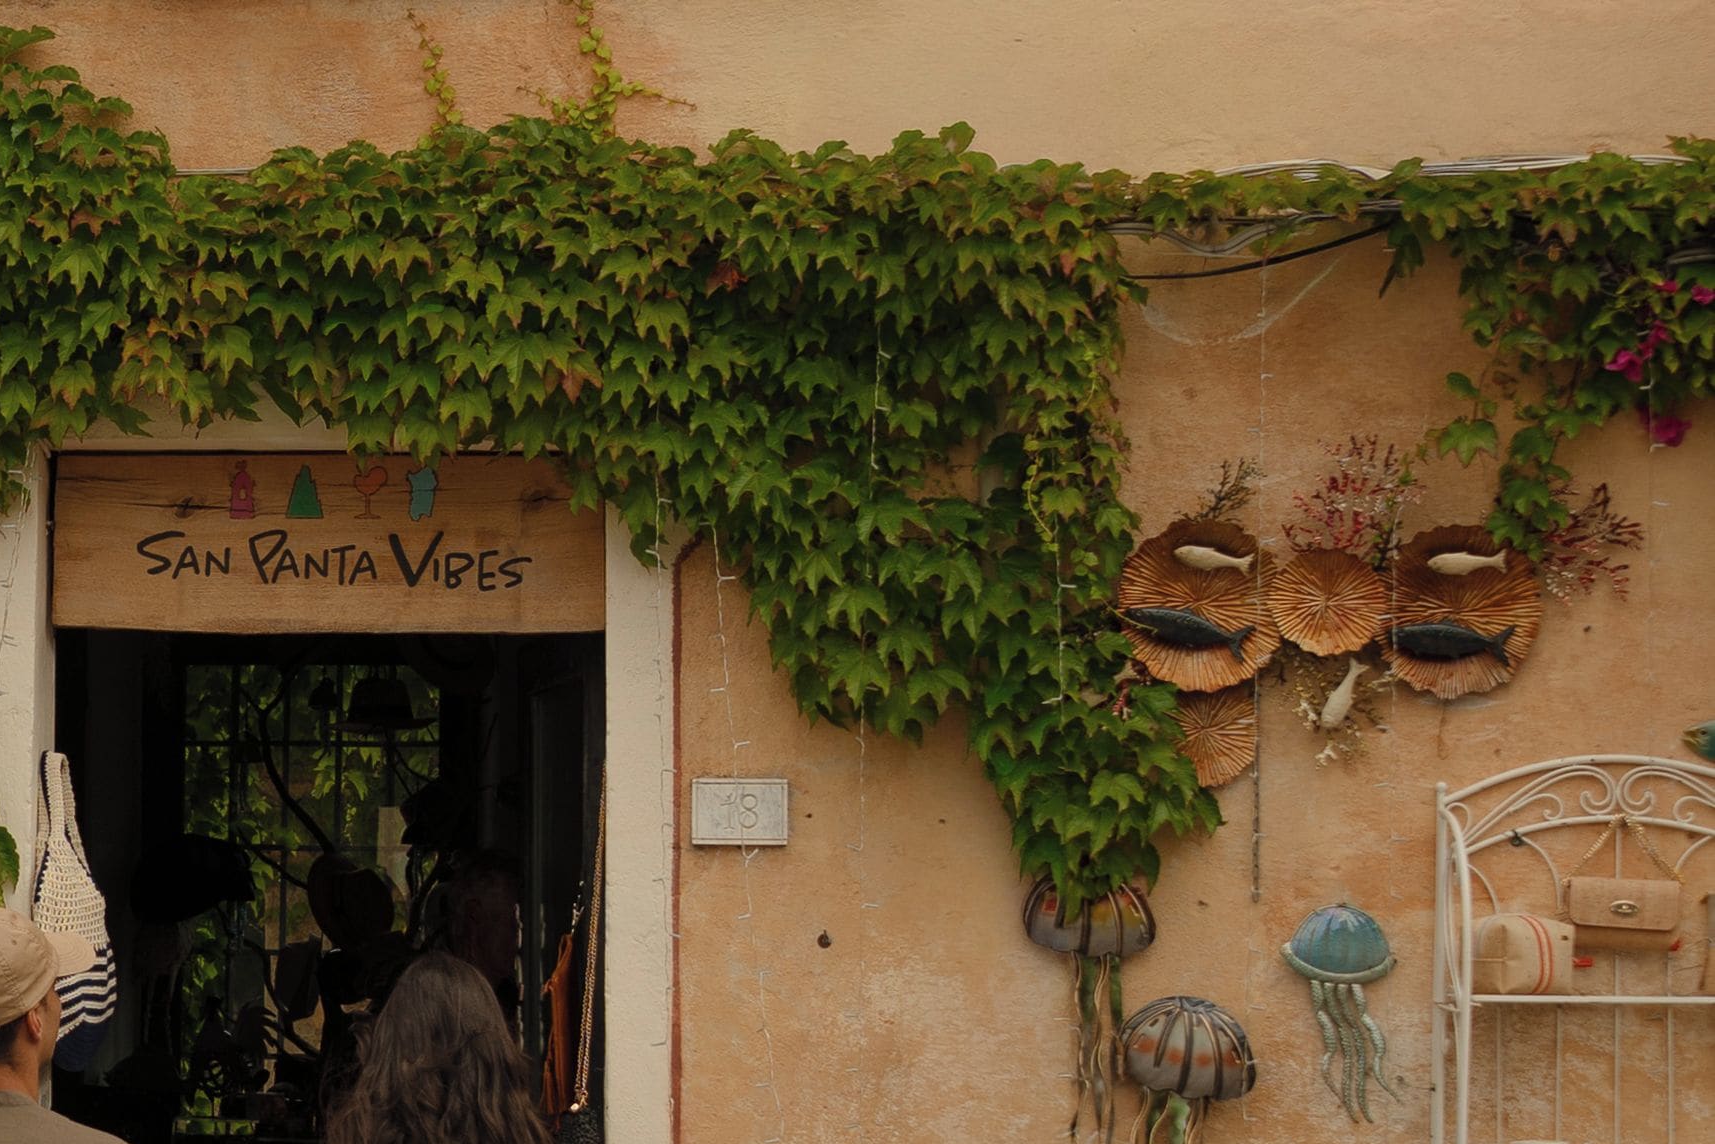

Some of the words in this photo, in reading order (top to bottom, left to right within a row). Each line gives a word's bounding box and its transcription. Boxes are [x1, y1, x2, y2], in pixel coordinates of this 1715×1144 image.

[136, 530, 231, 580] SAN
[247, 529, 378, 586] PANTA
[388, 530, 533, 592] VIBES
[722, 792, 759, 830] 18
